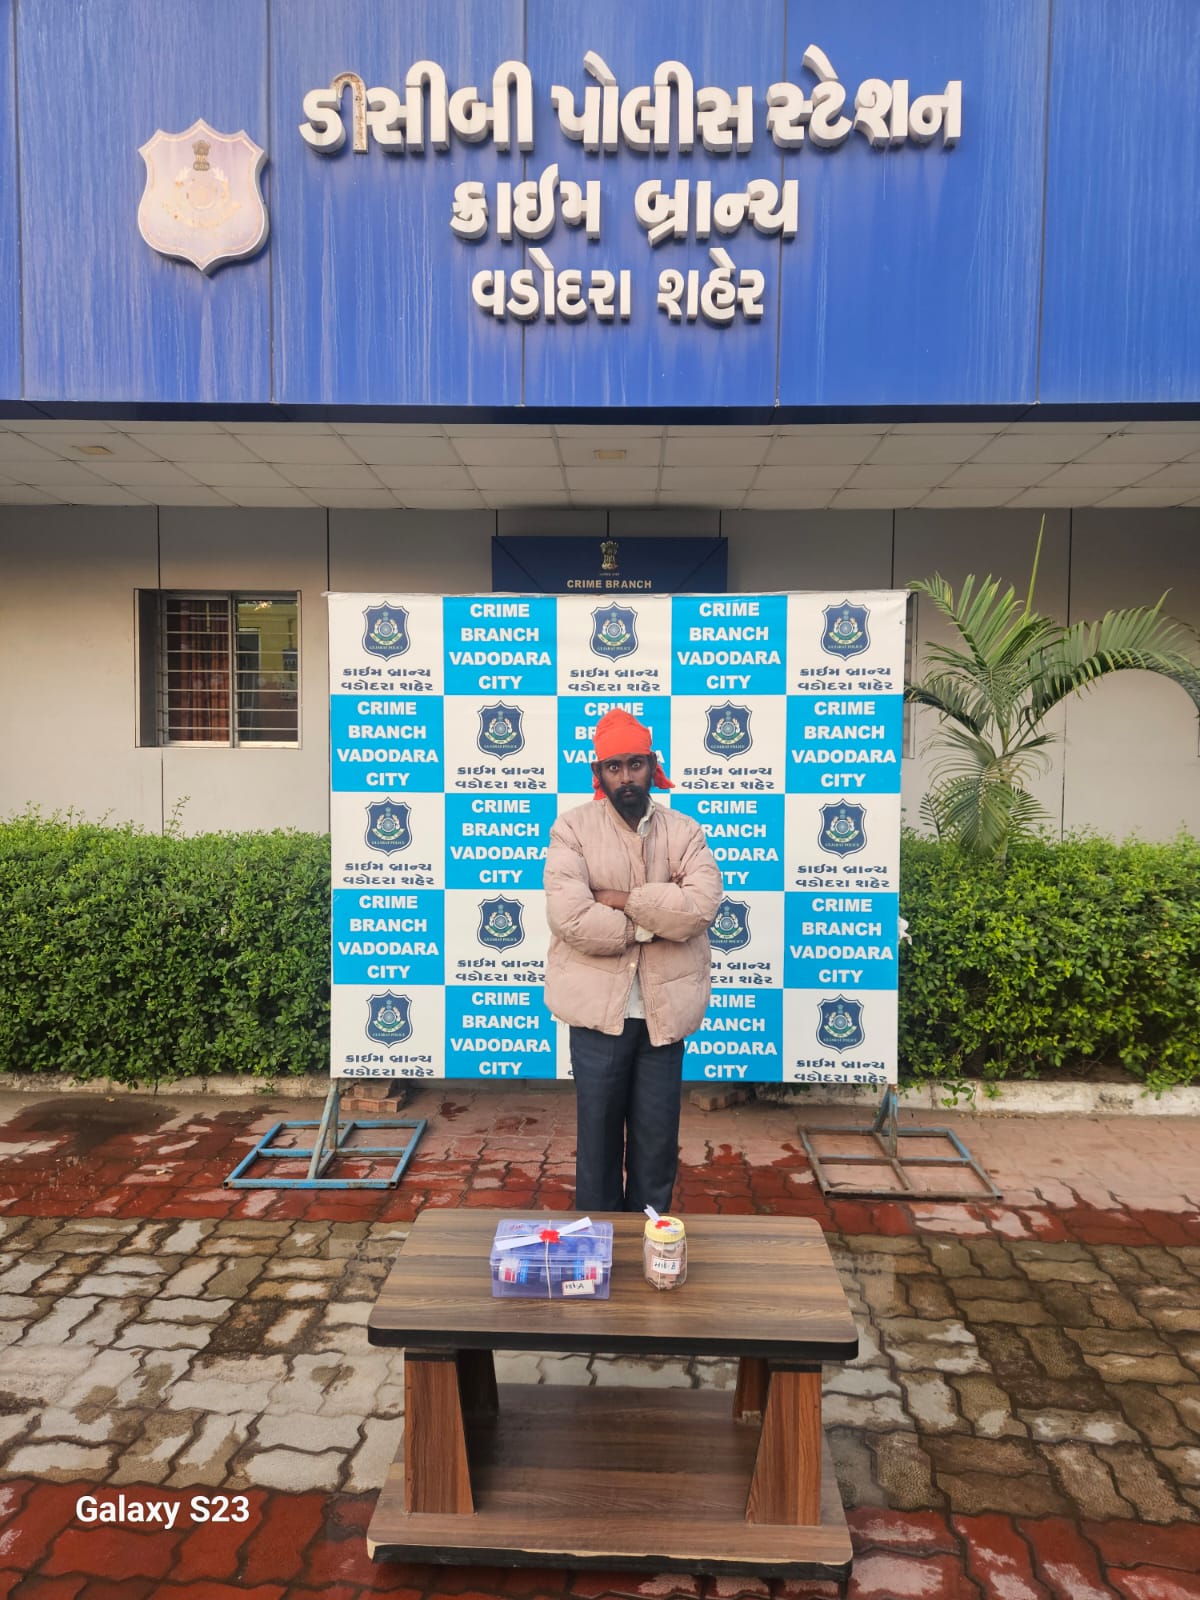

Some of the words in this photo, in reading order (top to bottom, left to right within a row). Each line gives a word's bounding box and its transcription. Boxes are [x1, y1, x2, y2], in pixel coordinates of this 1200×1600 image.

[298, 60, 534, 153] ડીસીબી
[551, 50, 753, 153] પોલીસ
[766, 44, 962, 149] સ્ટેશન
[450, 163, 600, 240] ક્રાઈમ
[635, 179, 798, 246] બ્રાન્ચ
[472, 248, 631, 320] વડોદરા
[657, 248, 765, 323] શહેર
[566, 579, 602, 589] CRIME
[605, 579, 652, 589] BRANCH
[469, 603, 530, 618] CRIME
[699, 601, 760, 617] CRIME
[460, 627, 540, 642] BRANCH
[689, 626, 769, 642] BRANCH
[449, 651, 552, 666] VADODARA
[677, 650, 781, 666] VADODARA
[340, 679, 394, 691] વડોદરા
[399, 679, 433, 692] શહેર
[478, 675, 523, 690] CITY
[567, 680, 621, 692] વડોદરા
[626, 680, 660, 693] શહેર
[706, 674, 751, 690] CITY
[797, 679, 853, 691] વડોદરા
[858, 678, 893, 691] શહેર
[357, 701, 417, 716] CRIME
[814, 701, 876, 716] CRIME
[348, 724, 427, 739] BRANCH
[804, 725, 885, 740] BRANCH
[336, 748, 439, 763] VADODARA
[791, 749, 897, 764] VADODARA
[365, 772, 410, 786] CITY
[454, 777, 508, 789] વડોદરા
[513, 777, 547, 790] શહેર
[681, 778, 735, 790] વડોદરા
[739, 777, 775, 791] શહેર
[820, 773, 866, 788] CITY
[471, 799, 531, 814] CRIME
[697, 800, 757, 815] CRIME
[462, 822, 540, 837] BRANCH
[700, 823, 767, 838] RANCH
[708, 847, 780, 862] ODARA
[342, 873, 396, 885] વડોદરા
[401, 873, 435, 886] શહેર
[479, 869, 523, 884] CITY
[795, 876, 850, 888] વડોદરા
[855, 876, 890, 889] શહેર
[359, 895, 418, 909] CRIME
[811, 897, 873, 913] CRIME
[349, 918, 427, 933] BRANCH
[802, 921, 882, 937] BRANCH
[337, 941, 439, 956] VADODARA
[789, 945, 894, 960] VADODARA
[367, 965, 411, 979] CITY
[455, 970, 508, 982] વડોદરા
[513, 970, 546, 983] શહેર
[738, 972, 773, 985] શહેર
[818, 969, 864, 983] CITY
[471, 992, 531, 1006] CRIME
[709, 994, 756, 1009] RIME
[462, 1015, 540, 1029] BRANCH
[700, 1017, 765, 1032] RANCH
[450, 1038, 551, 1053] VADODARA
[684, 1041, 778, 1055] ADODARA
[342, 1065, 396, 1077] વડોદરા
[401, 1065, 434, 1078] શહેર
[478, 1061, 523, 1075] CITY
[704, 1064, 748, 1078] CITY
[794, 1070, 848, 1083] વડોદરા
[853, 1071, 888, 1084] શહેર
